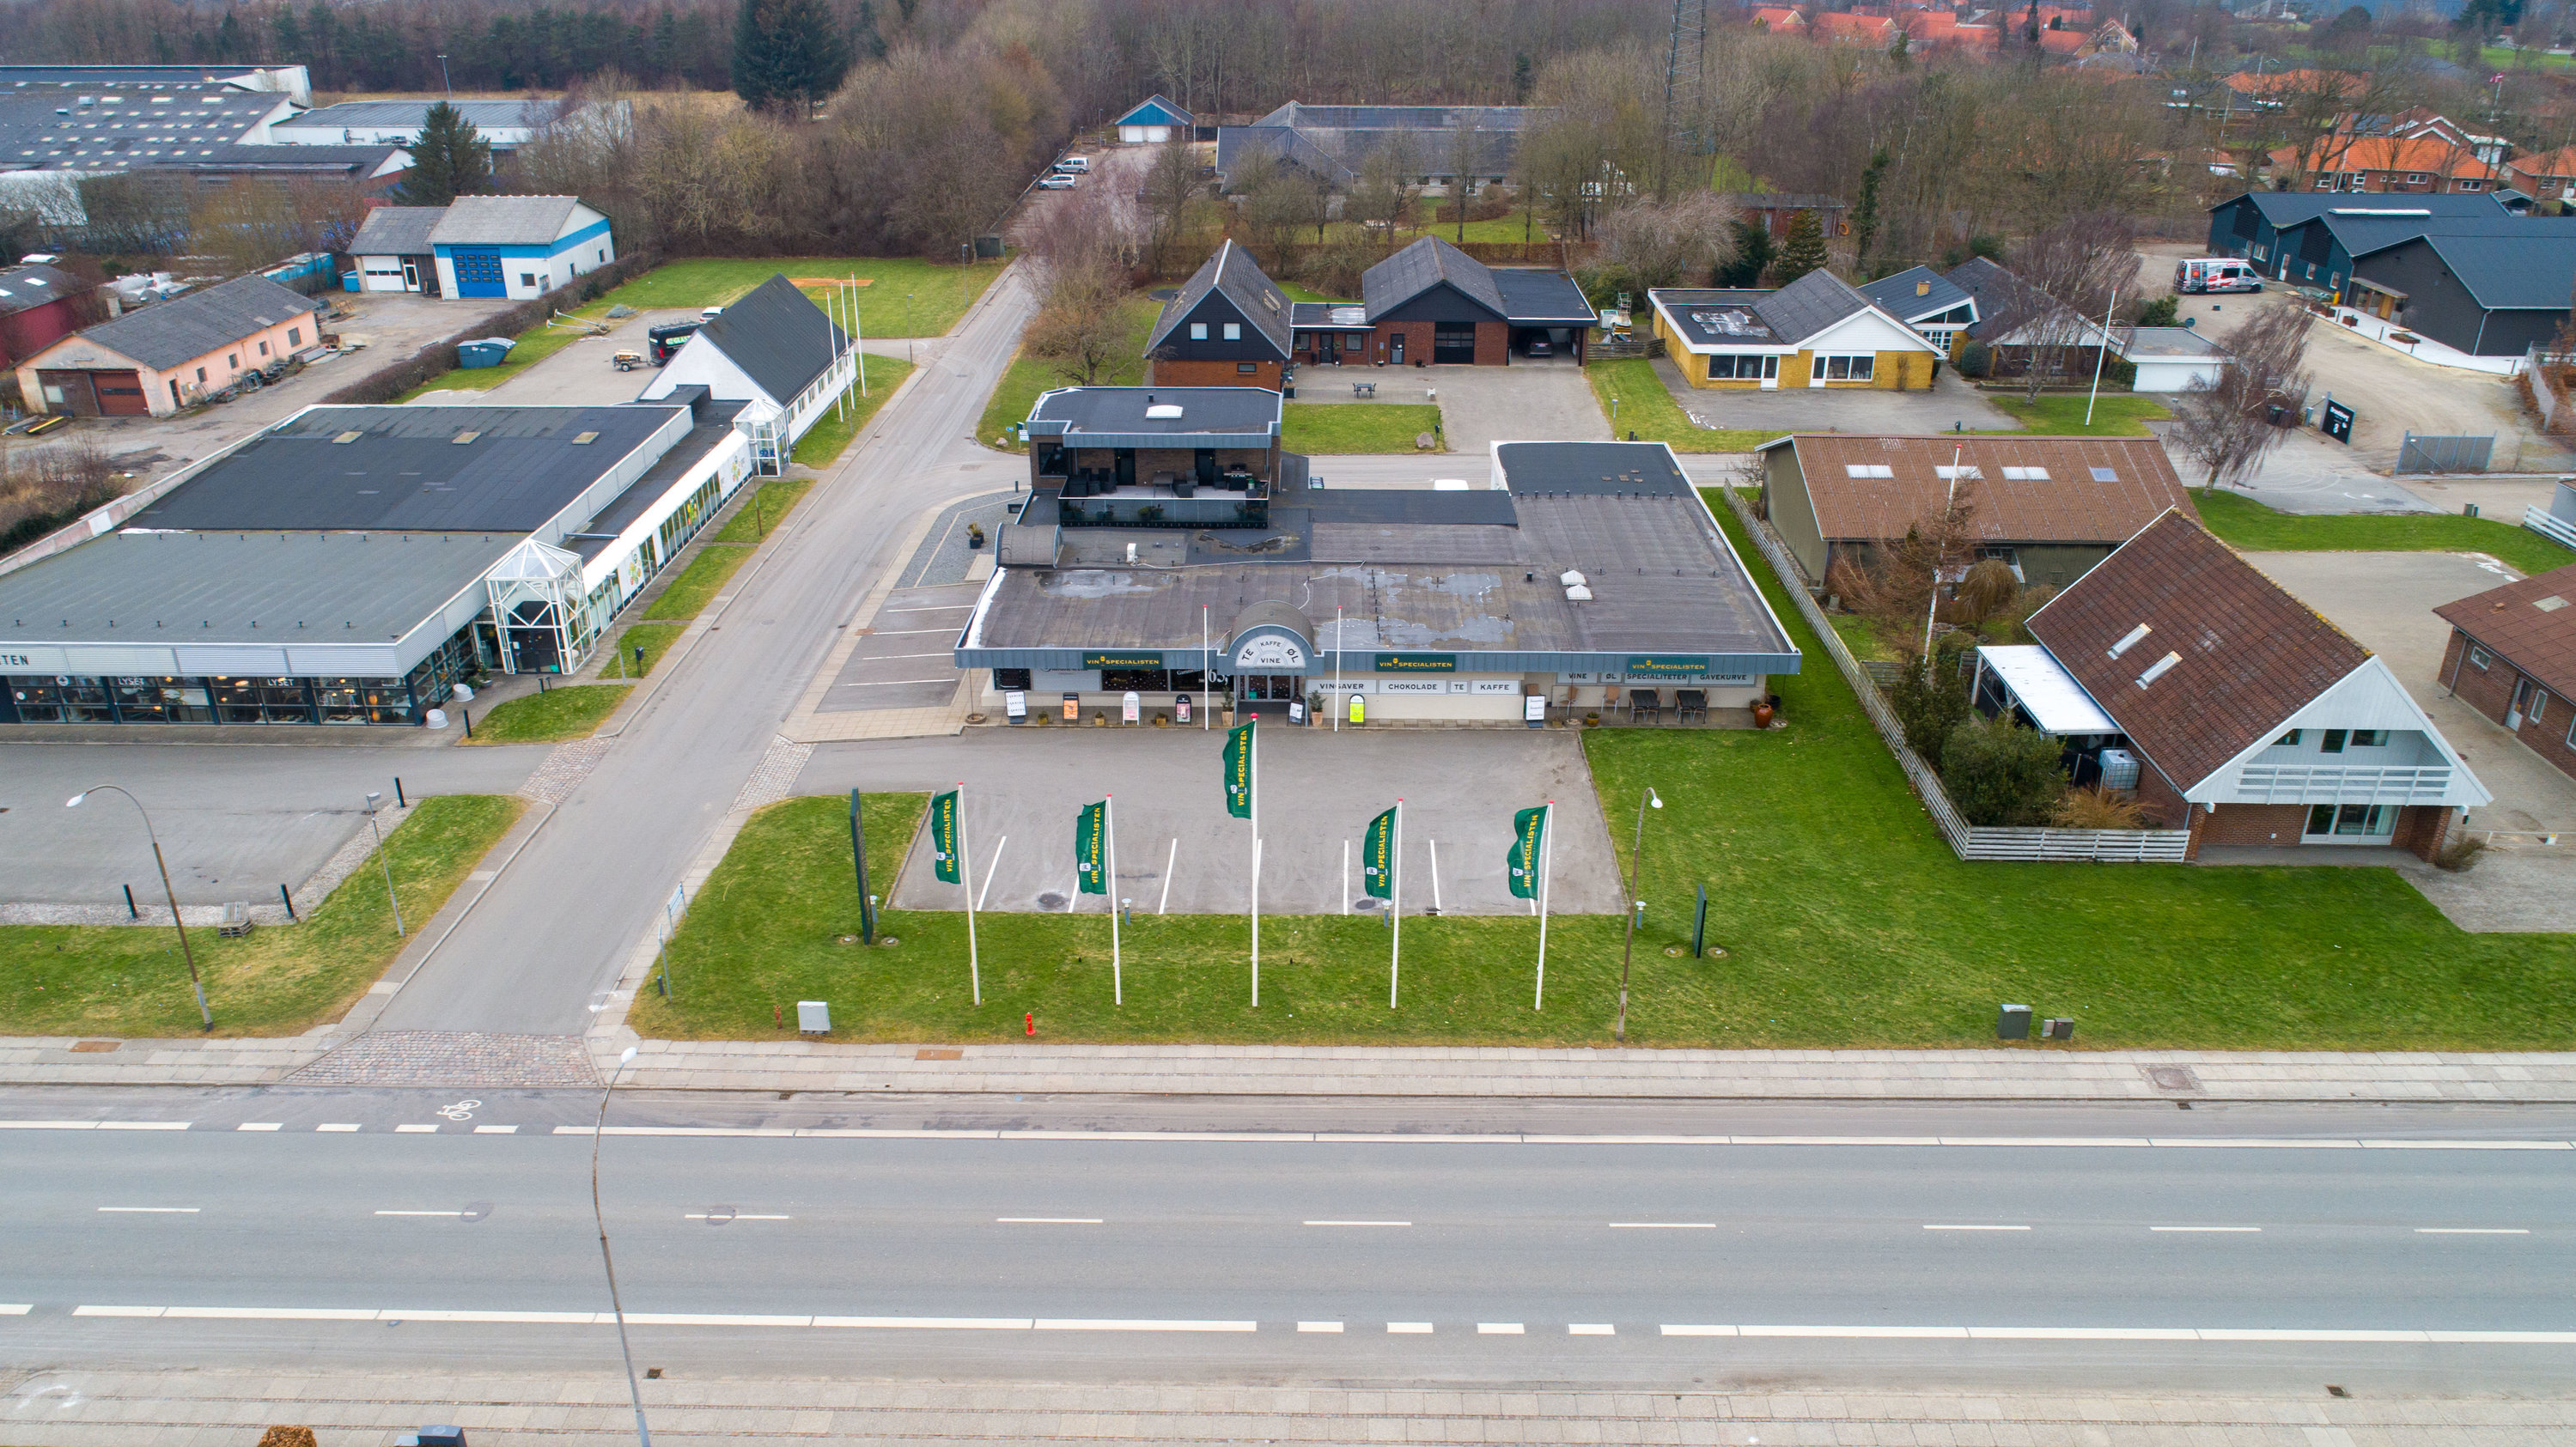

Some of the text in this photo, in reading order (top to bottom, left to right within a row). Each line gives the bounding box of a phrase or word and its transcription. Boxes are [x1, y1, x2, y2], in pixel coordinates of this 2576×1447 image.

[0, 655, 29, 666] TEN
[1242, 648, 1254, 660] TE
[1287, 648, 1299, 663] ØL
[1238, 730, 1247, 787] SPECIALISTEN
[943, 799, 952, 854] SPECIALISTEN
[1092, 807, 1100, 865] SPECIALISTEN
[1379, 815, 1388, 869] SPECIALISTEN
[1525, 814, 1538, 870] SPECIALISTEN
